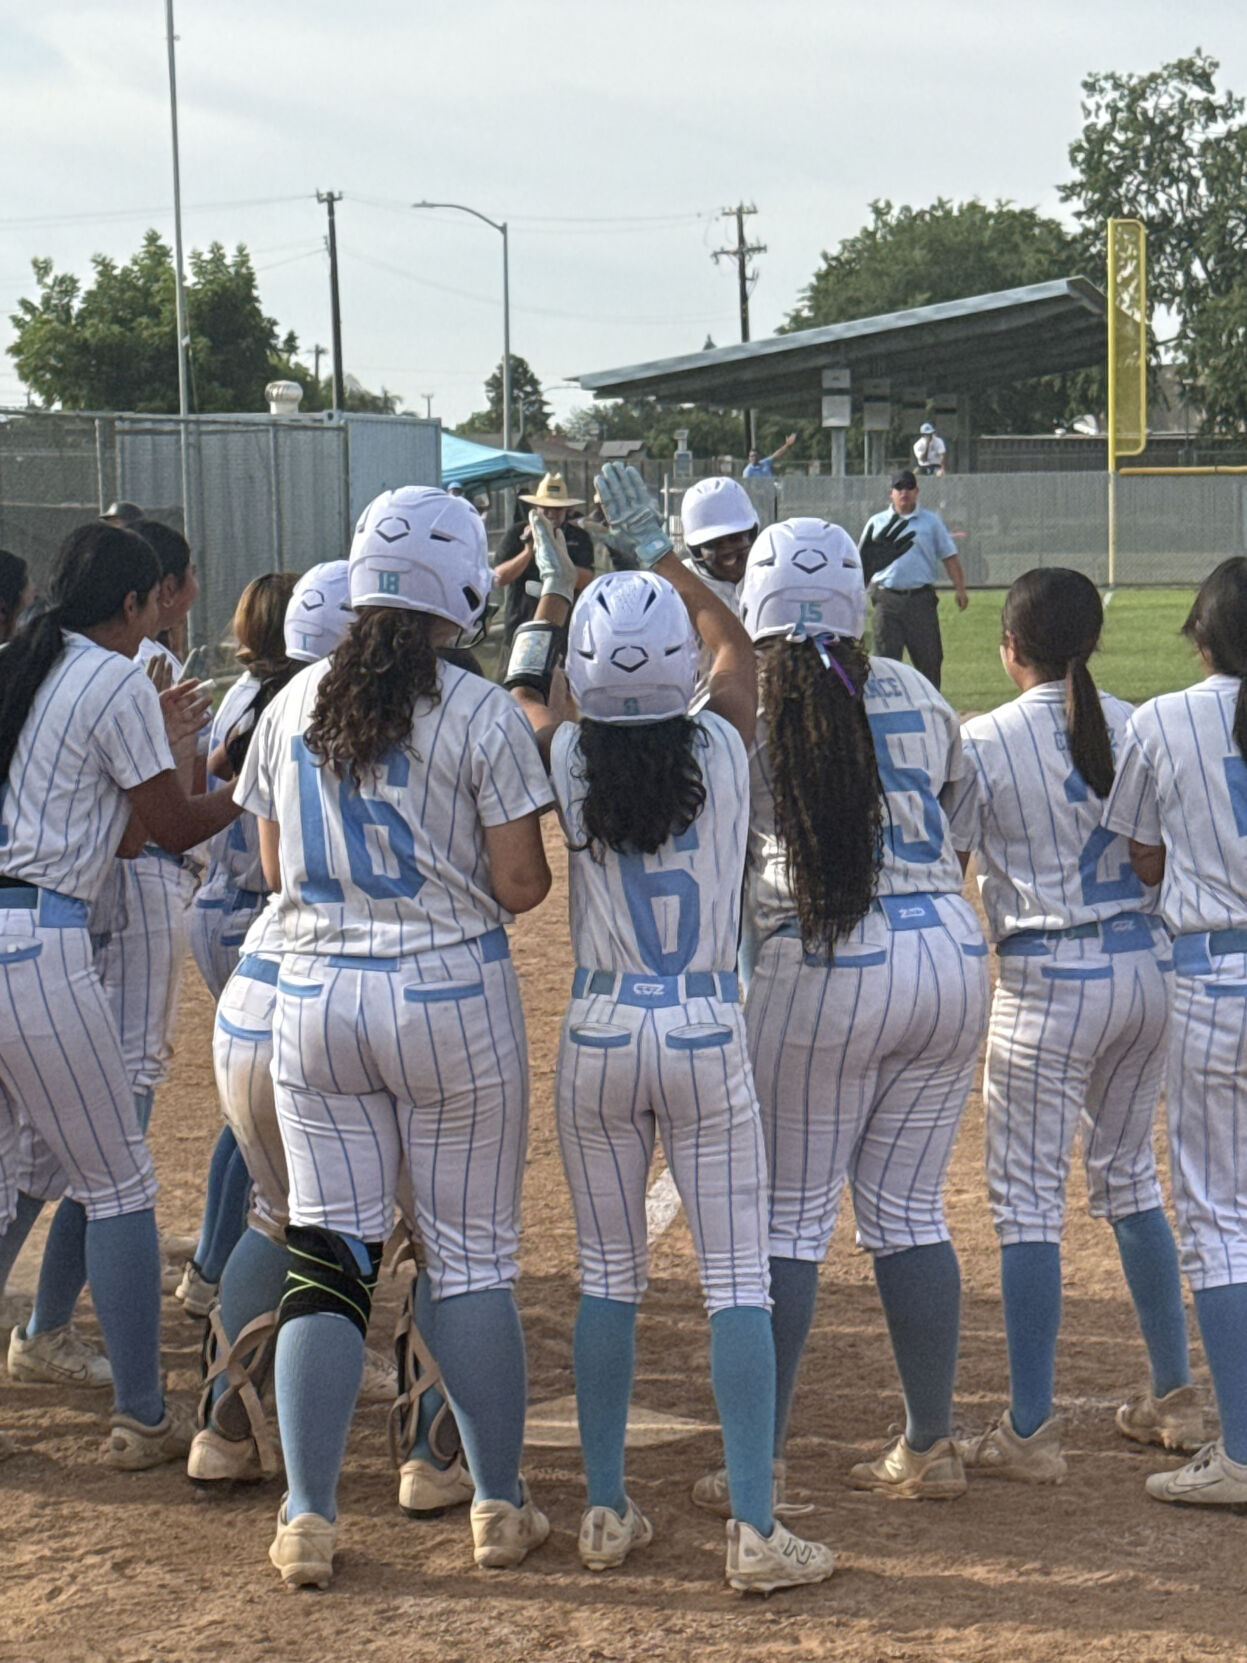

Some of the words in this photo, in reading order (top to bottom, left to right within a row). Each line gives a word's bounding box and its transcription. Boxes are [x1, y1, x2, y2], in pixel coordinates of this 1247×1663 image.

[379, 571, 400, 594] 18
[800, 601, 823, 623] 15
[290, 735, 428, 905] 16
